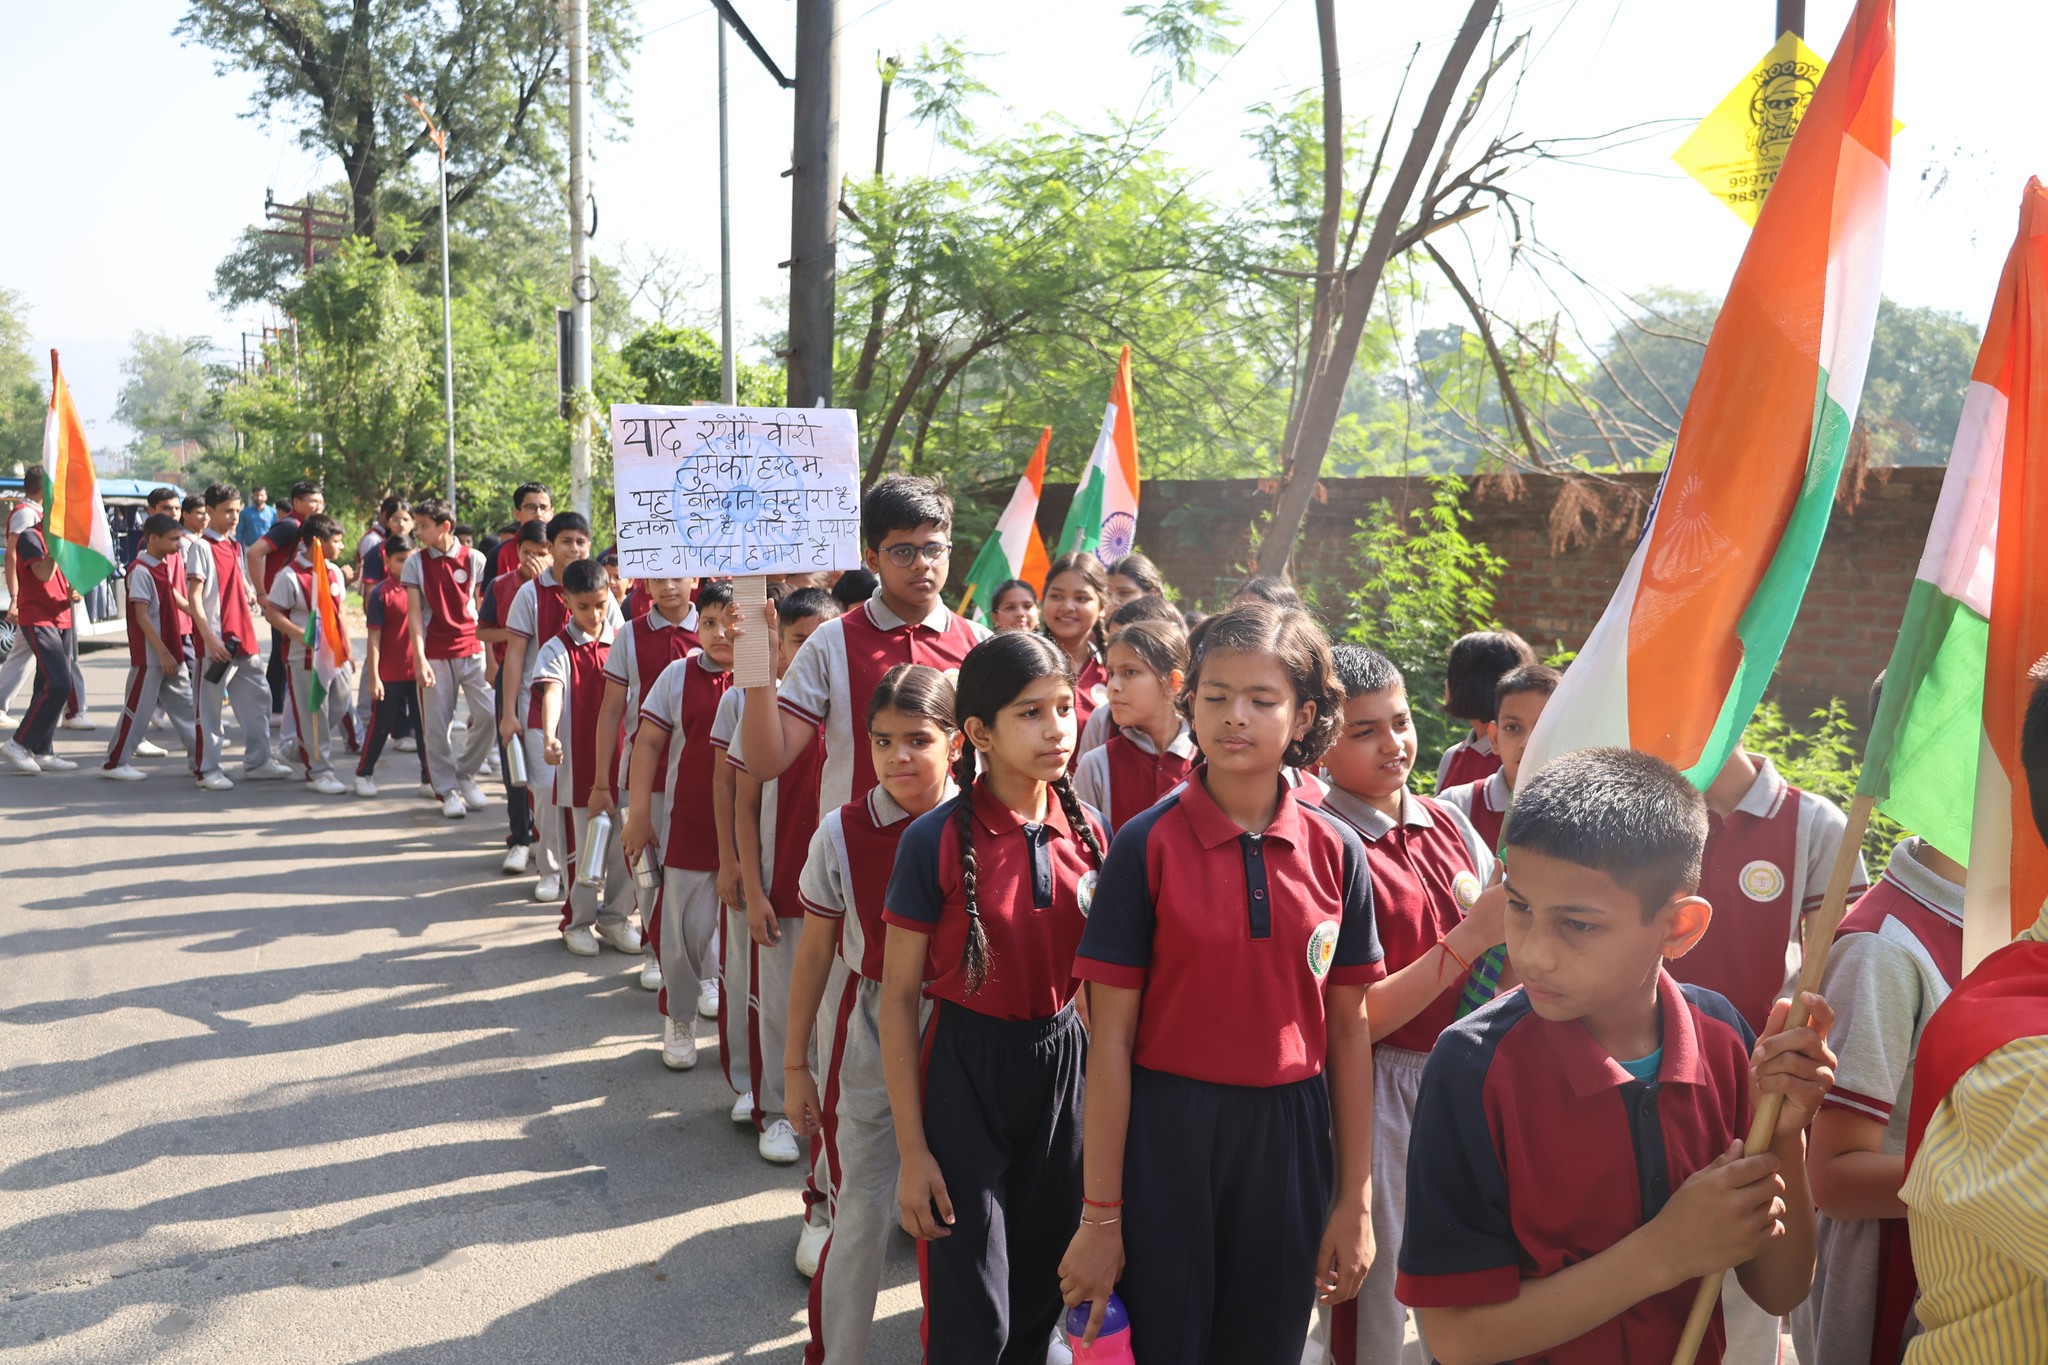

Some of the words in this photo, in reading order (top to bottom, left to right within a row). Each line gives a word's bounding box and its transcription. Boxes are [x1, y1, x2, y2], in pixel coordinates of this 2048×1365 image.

[1753, 61, 1819, 88] MOODY
[1729, 171, 1778, 189] 99970
[1728, 188, 1768, 204] 9897
[619, 418, 687, 457] याद
[676, 445, 753, 491] तुमको
[629, 489, 677, 514] यह
[683, 483, 757, 511] बलिदान
[761, 489, 833, 520] तुम्हारा
[619, 513, 677, 539] हमको
[687, 512, 714, 540] तो
[720, 514, 735, 535] है
[744, 519, 787, 536] जान
[792, 515, 810, 536] से
[817, 518, 860, 538] प्यार
[622, 548, 663, 571] यह
[745, 543, 803, 571] हमारा
